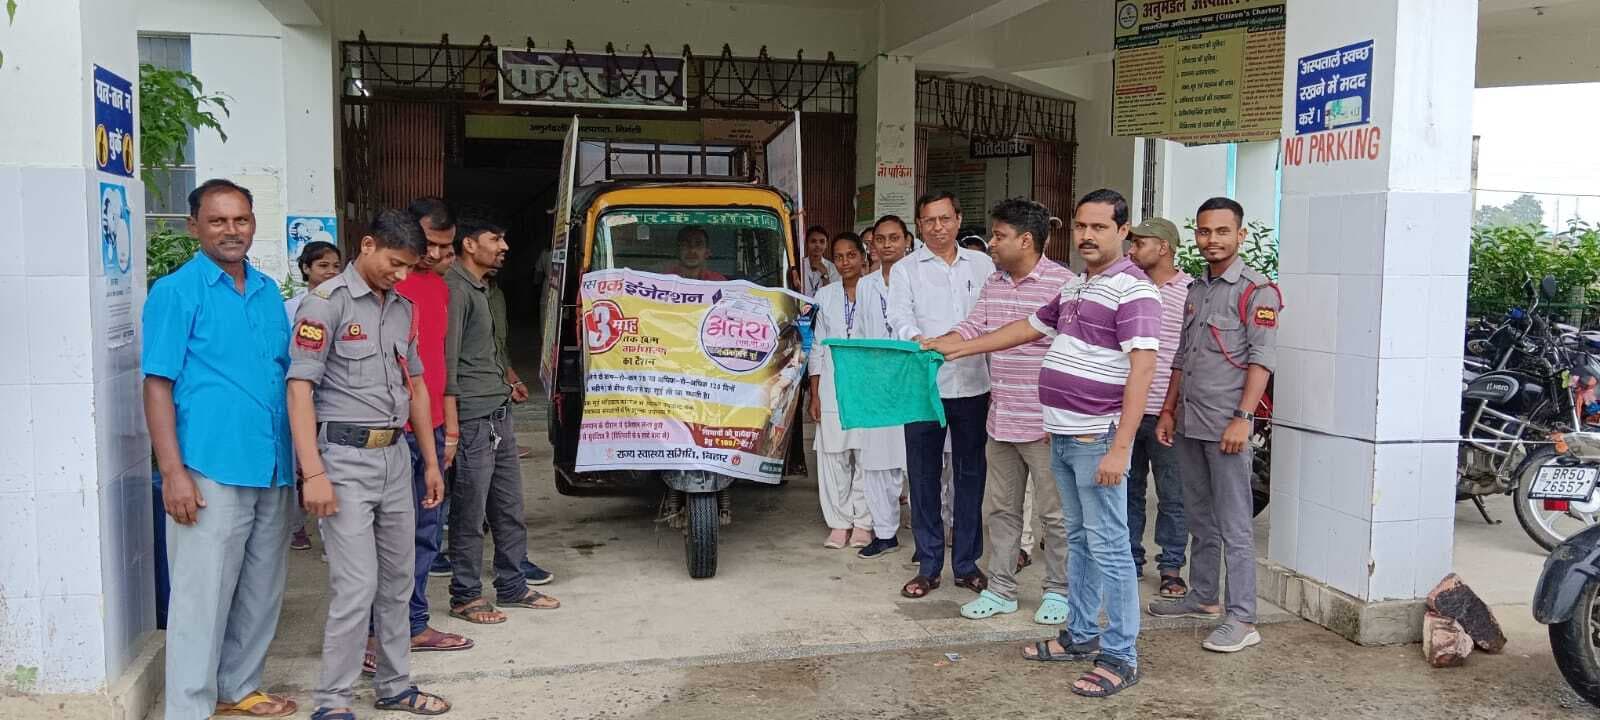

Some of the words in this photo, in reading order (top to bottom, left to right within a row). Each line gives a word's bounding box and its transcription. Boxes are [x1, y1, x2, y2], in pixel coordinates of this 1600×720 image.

[1300, 78, 1326, 101] रखने
[1340, 73, 1367, 92] मदद
[1285, 136, 1304, 167] NO
[1308, 126, 1380, 166] PARKING
[625, 281, 704, 304] इंजेक्शन
[300, 324, 323, 340] CSS
[612, 319, 638, 335] माह
[616, 449, 635, 459] राज्य
[637, 449, 664, 459] स्वास्थ्य
[702, 450, 728, 463] बिहार
[1552, 468, 1586, 480] BR50
[1543, 480, 1584, 493] Z6557
